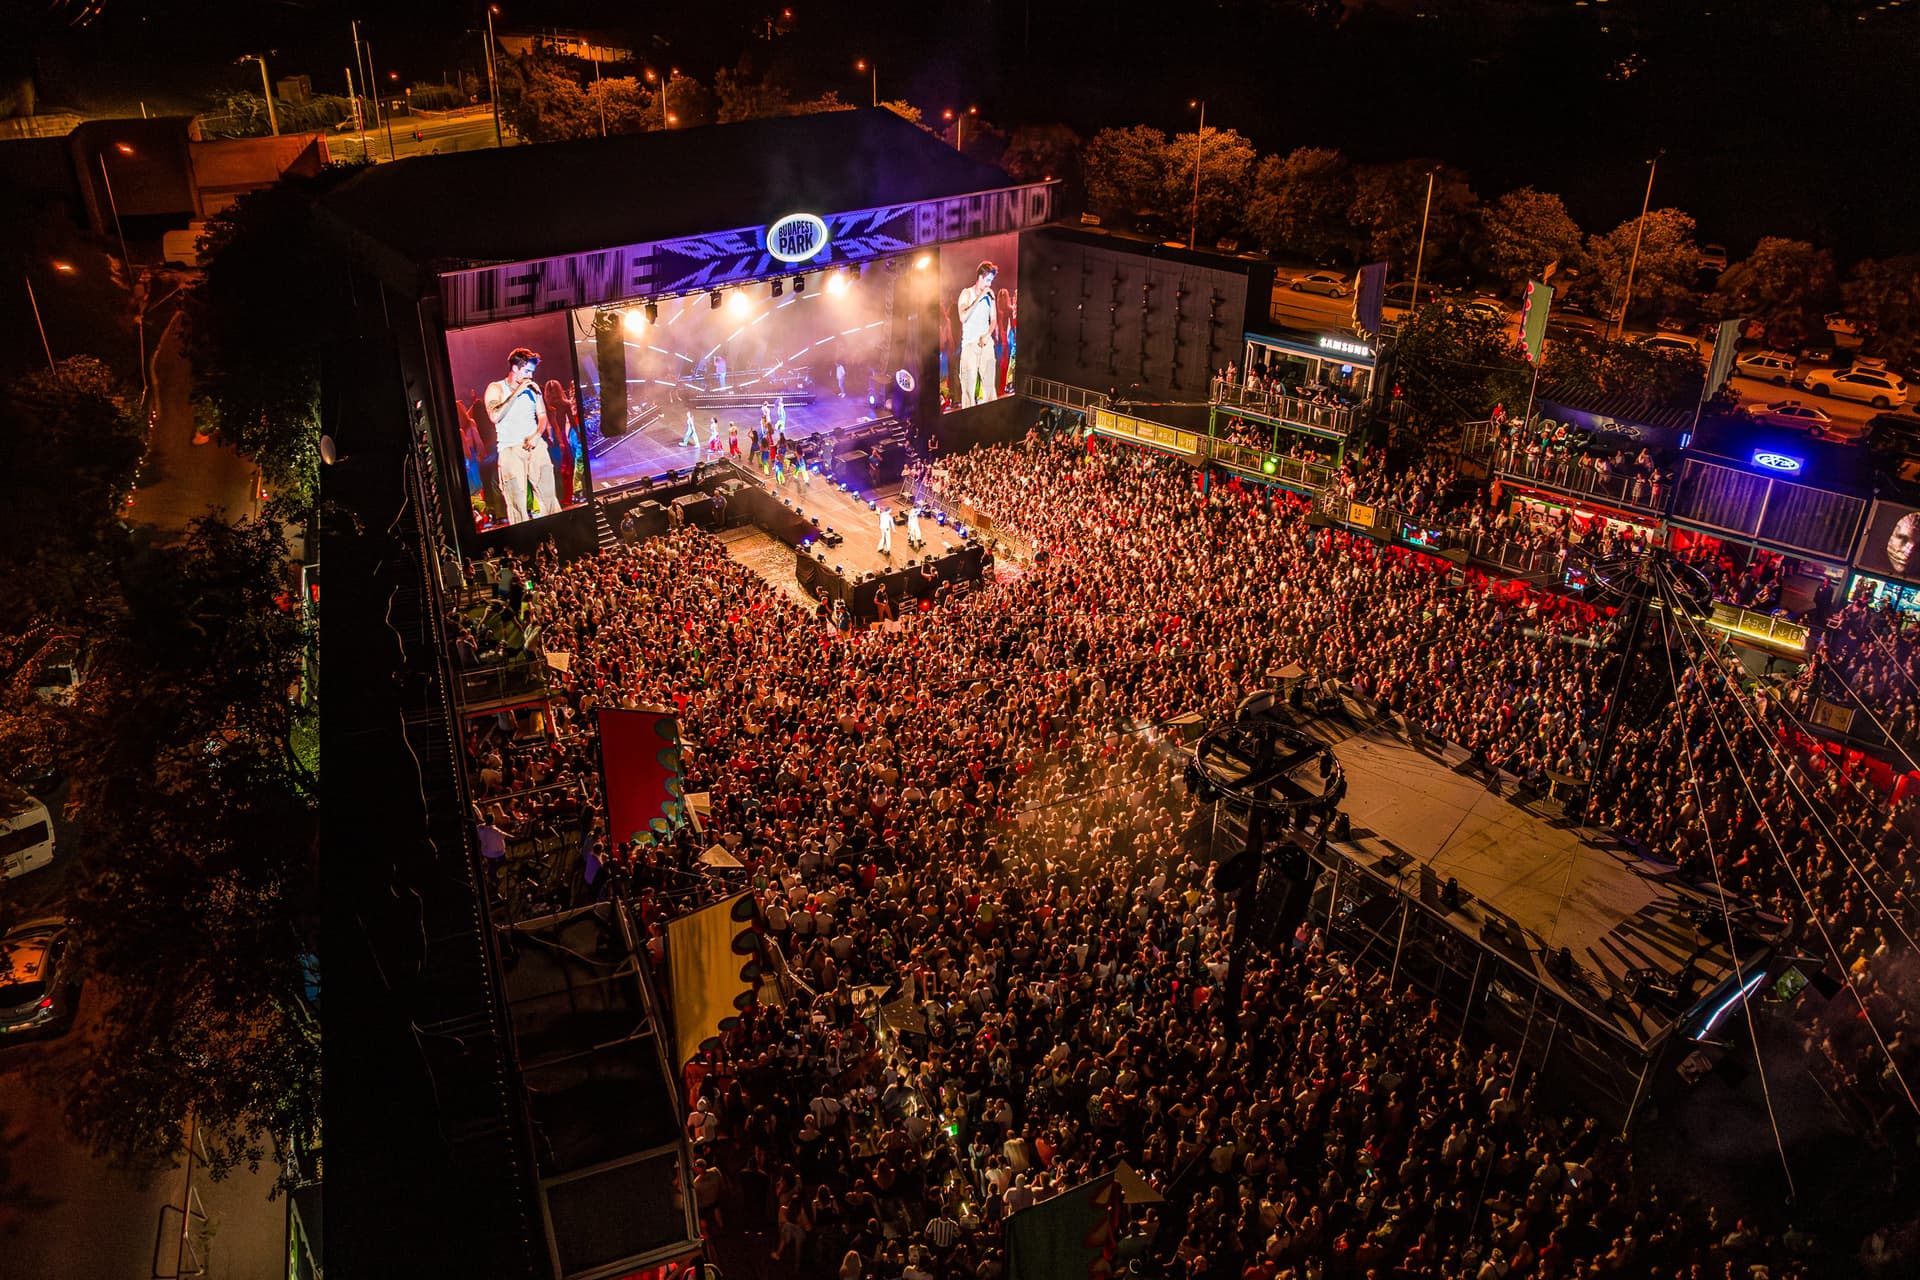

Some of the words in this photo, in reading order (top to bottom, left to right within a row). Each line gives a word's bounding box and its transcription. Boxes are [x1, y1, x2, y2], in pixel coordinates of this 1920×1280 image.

[914, 186, 1051, 244] BEHIND
[778, 220, 813, 237] BUDAPEST
[779, 232, 813, 255] PARK
[1320, 336, 1369, 356] SAMSUNG
